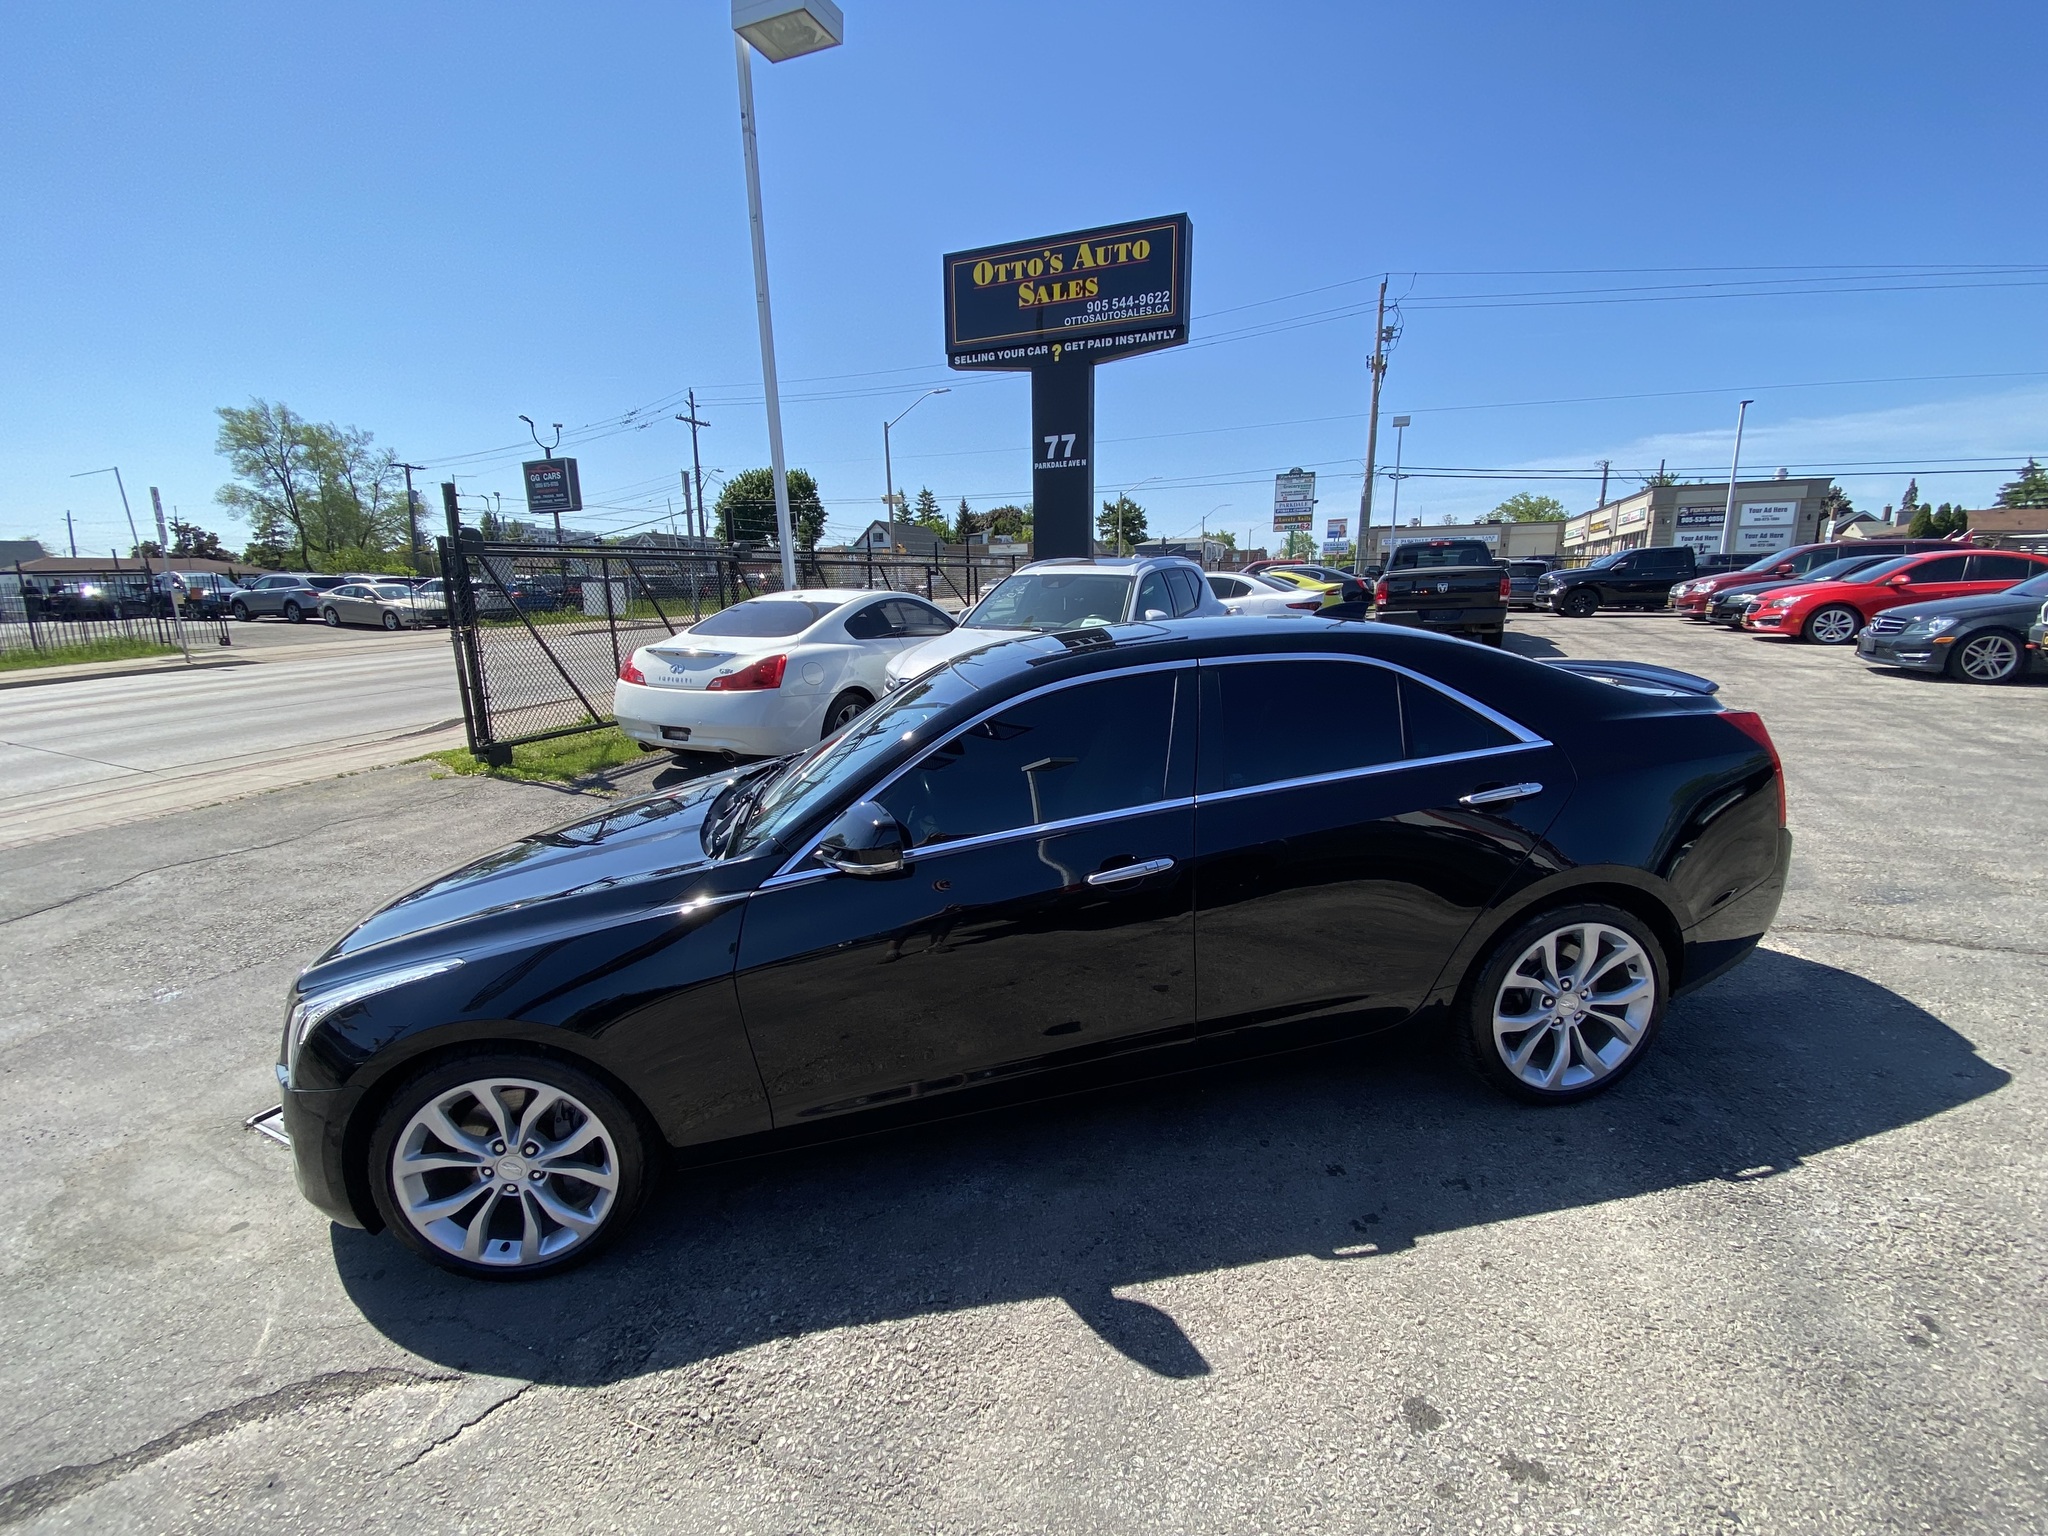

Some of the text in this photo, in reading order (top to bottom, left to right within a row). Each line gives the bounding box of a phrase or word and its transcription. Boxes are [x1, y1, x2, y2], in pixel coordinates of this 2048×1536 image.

[972, 239, 1151, 286] OTTO'S AUTO
[1018, 277, 1099, 308] SALES
[1086, 291, 1170, 313] 905 544-9622
[1064, 304, 1170, 326] OTTOSAUTOSALES.CA
[954, 352, 996, 365] SELLING
[997, 349, 1026, 360] YOUR
[1027, 345, 1049, 356] CAR
[1064, 341, 1086, 352] GET
[1087, 337, 1113, 349] PAID
[1115, 329, 1177, 345] INSTANTLY
[1044, 433, 1076, 459] 77
[542, 471, 562, 481] CARS
[1034, 460, 1067, 470] PARKDALE
[1068, 459, 1081, 468] AVE
